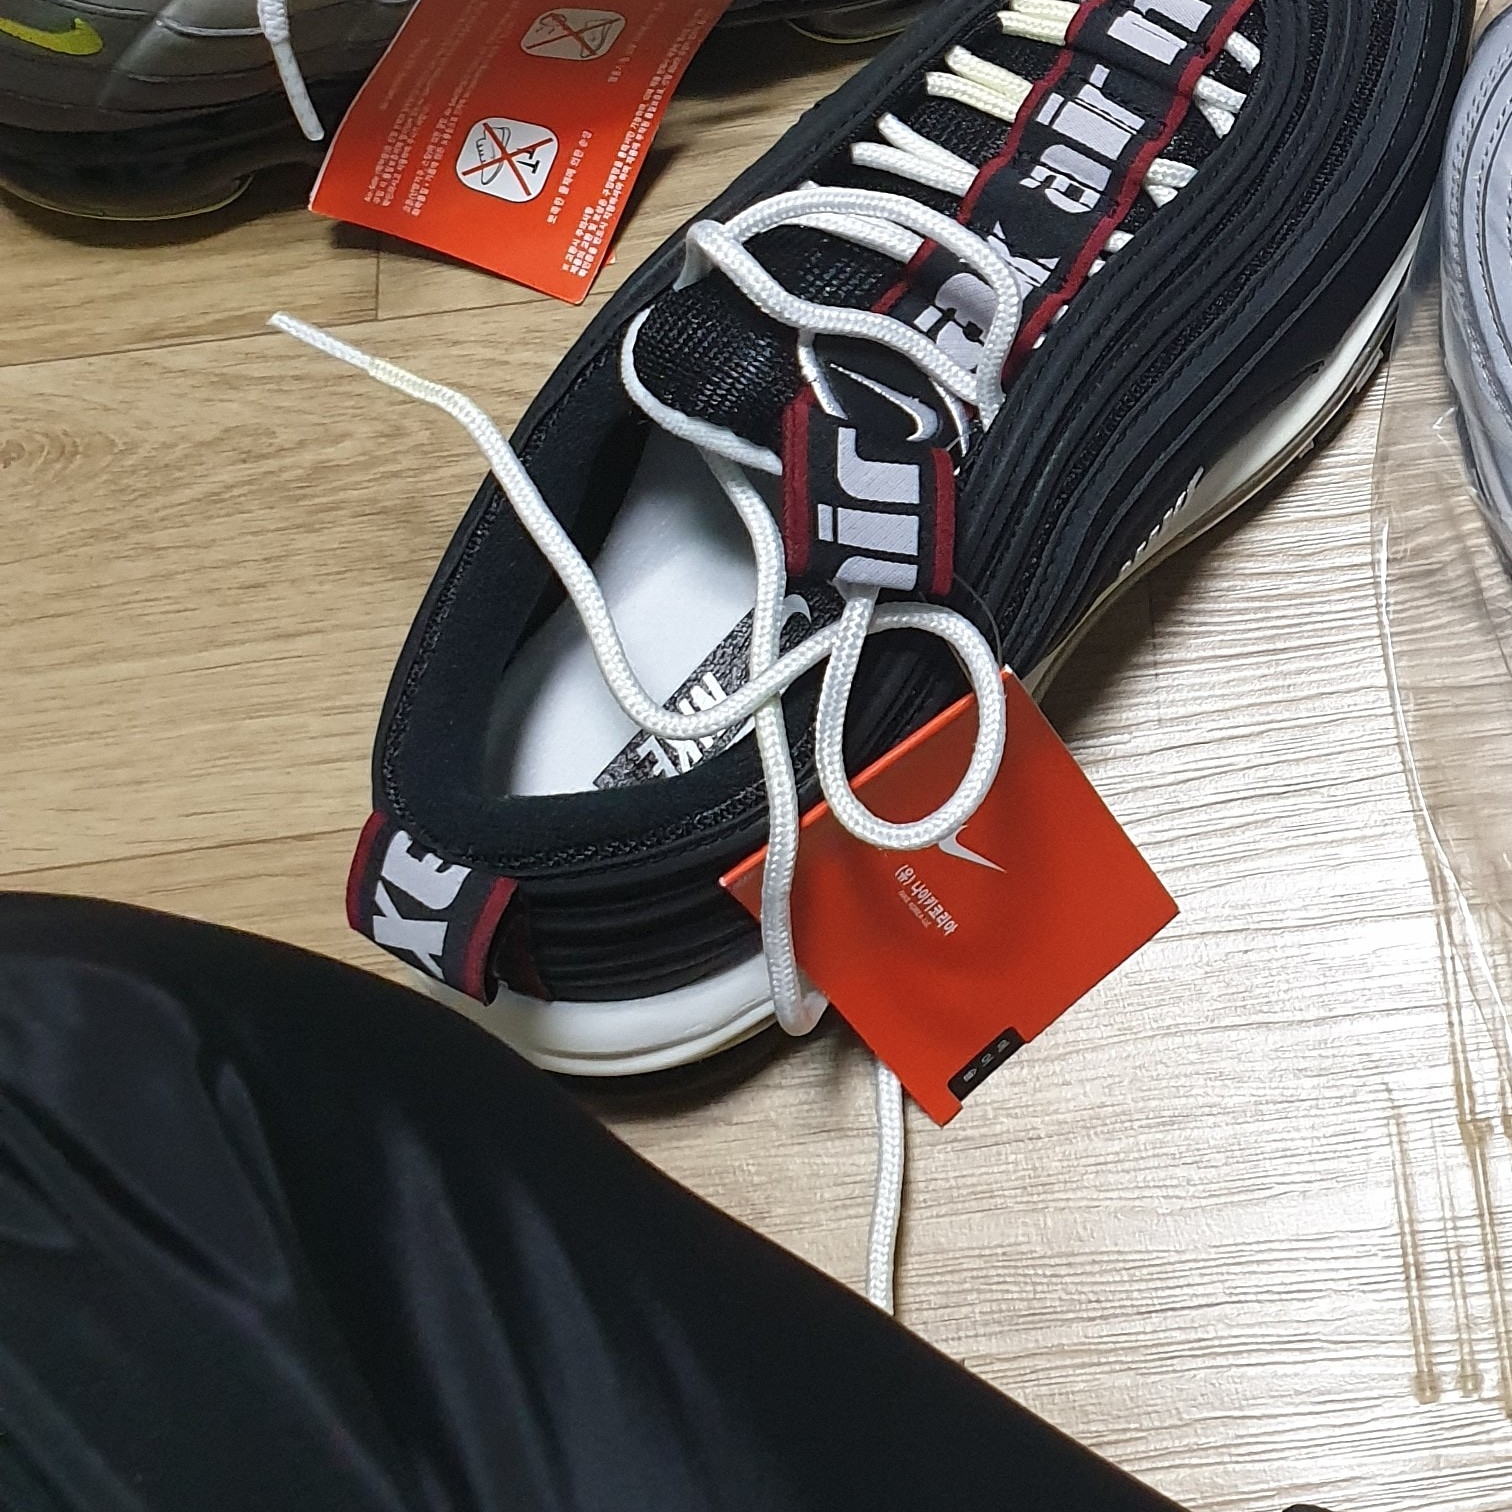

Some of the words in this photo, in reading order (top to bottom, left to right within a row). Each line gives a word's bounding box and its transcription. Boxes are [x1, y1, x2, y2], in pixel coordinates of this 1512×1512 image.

[1020, 63, 1144, 217] air
[894, 864, 915, 885] (유)
[910, 880, 958, 935] 나이키코리아
